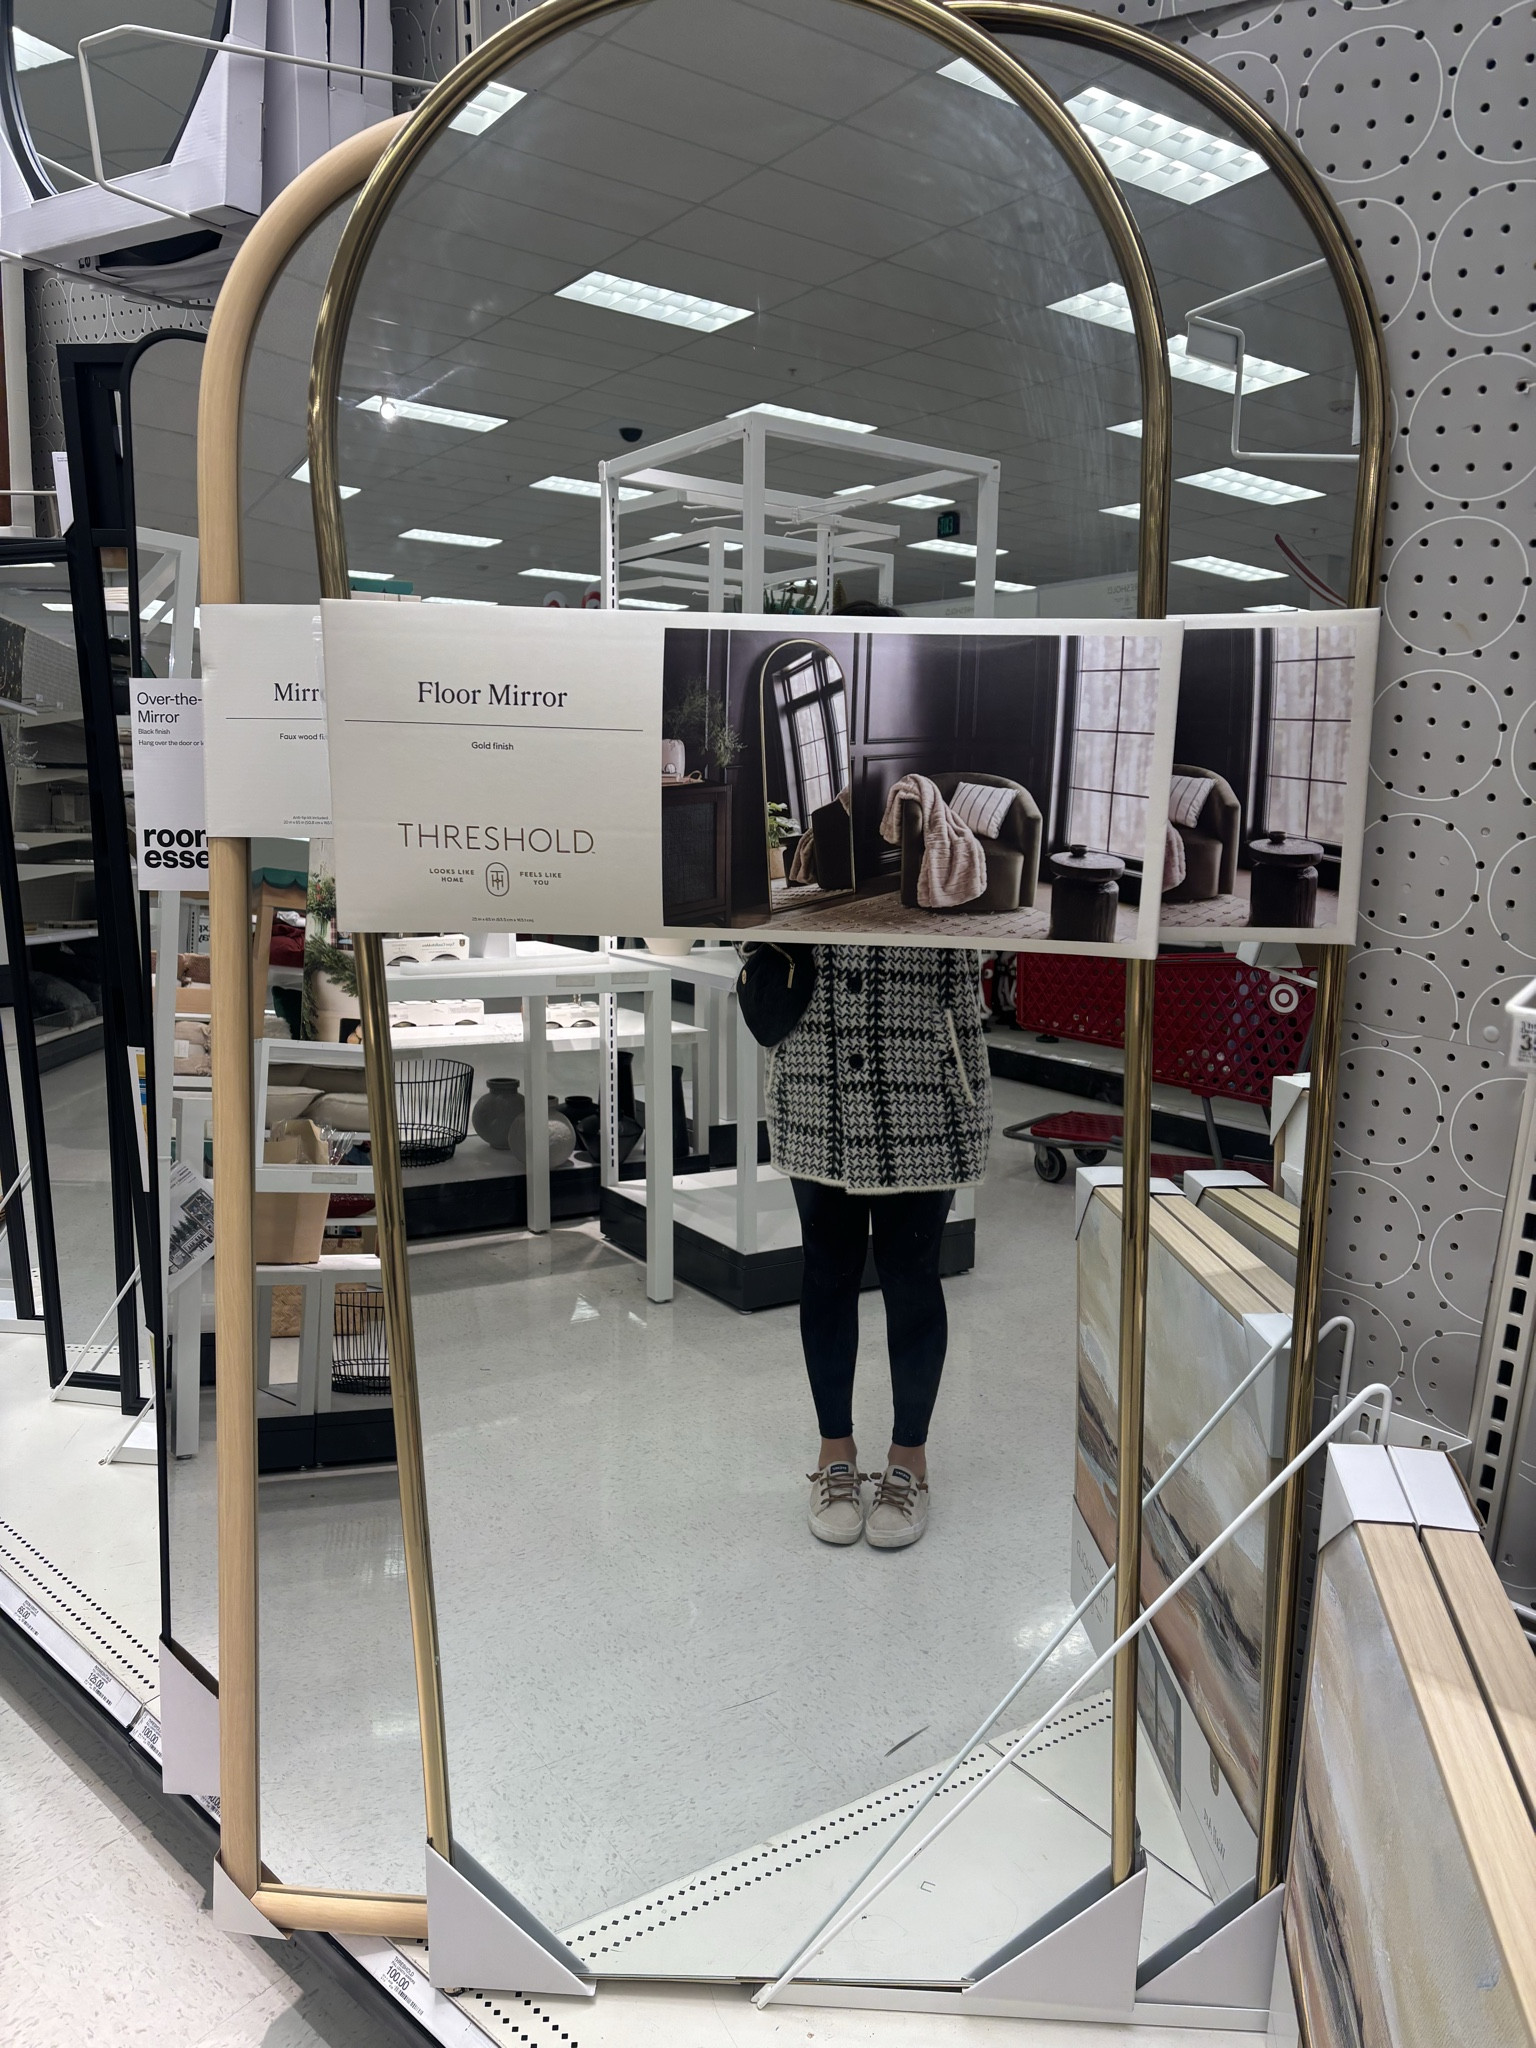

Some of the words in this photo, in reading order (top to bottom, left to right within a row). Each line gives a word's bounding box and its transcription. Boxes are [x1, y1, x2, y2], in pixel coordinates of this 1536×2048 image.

[136, 692, 202, 706] Over-the-
[418, 681, 482, 705] Floor
[488, 684, 568, 708] Mirror
[138, 710, 180, 724] Mirror
[318, 733, 327, 741] fi
[471, 742, 491, 750] Gold
[492, 742, 514, 751] finish
[398, 822, 594, 854] THRESHOLD
[144, 850, 209, 869] esse
[429, 868, 456, 876] LOOKS
[87, 1672, 104, 1690] 125.00
[141, 1725, 159, 1745] 100.00
[395, 1956, 414, 1977] THRESHOLD
[386, 1965, 409, 1990] 100.00
